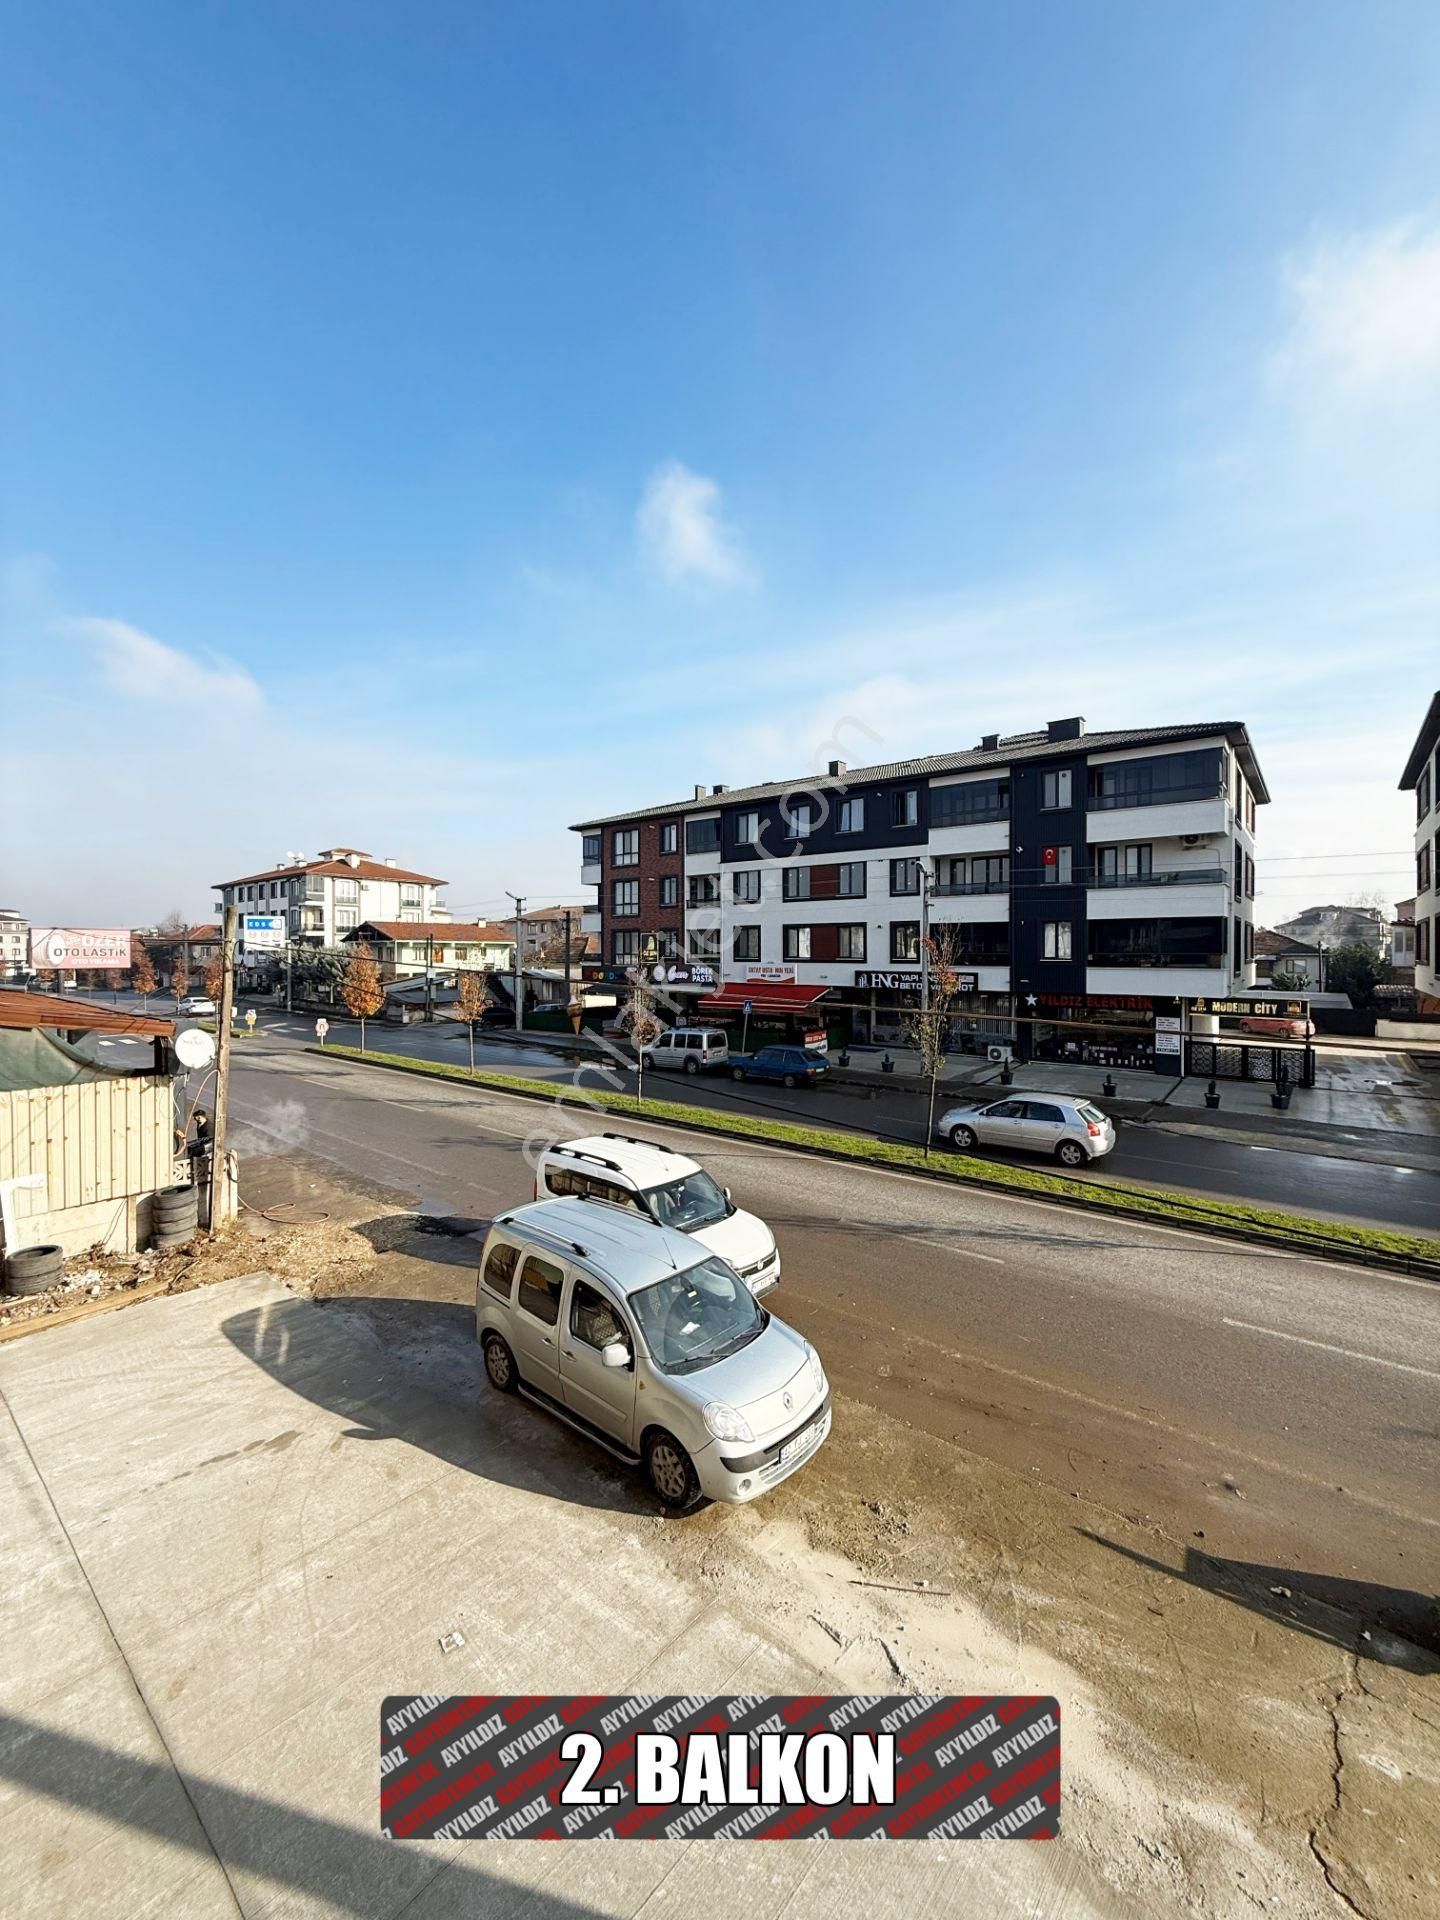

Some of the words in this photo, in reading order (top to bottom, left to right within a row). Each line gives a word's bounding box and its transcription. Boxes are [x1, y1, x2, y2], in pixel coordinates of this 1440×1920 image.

[53, 948, 80, 957] OTO
[83, 947, 127, 957] LASTİK
[691, 965, 713, 975] BÖREK
[692, 974, 713, 983] PASTA
[872, 973, 899, 988] HNG
[899, 982, 924, 990] BETO
[1040, 993, 1082, 1007] YILDIZ
[1211, 1001, 1251, 1014] MODERN
